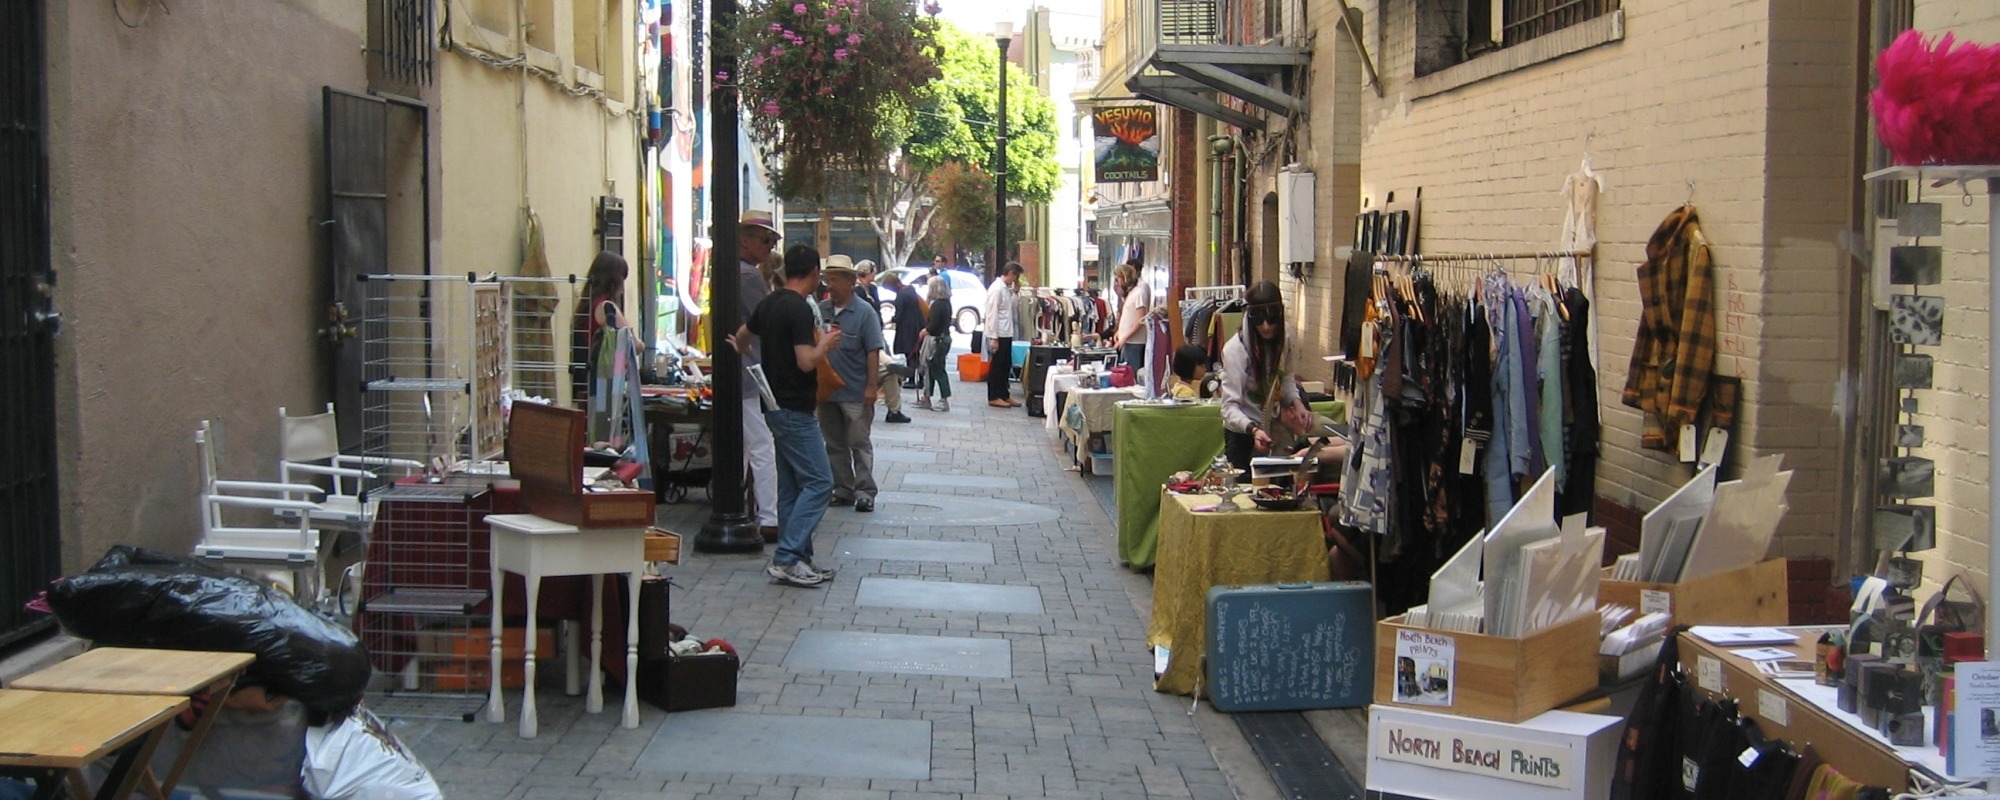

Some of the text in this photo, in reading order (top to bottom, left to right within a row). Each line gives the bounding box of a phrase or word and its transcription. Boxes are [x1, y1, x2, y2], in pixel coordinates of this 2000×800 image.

[1095, 107, 1152, 124] VESUVIO
[1104, 170, 1148, 180] COCKTAILS
[1409, 644, 1438, 657] PRINTS
[1971, 672, 1999, 681] October
[1388, 728, 1441, 760] NORTH
[1452, 738, 1500, 771] BEACH
